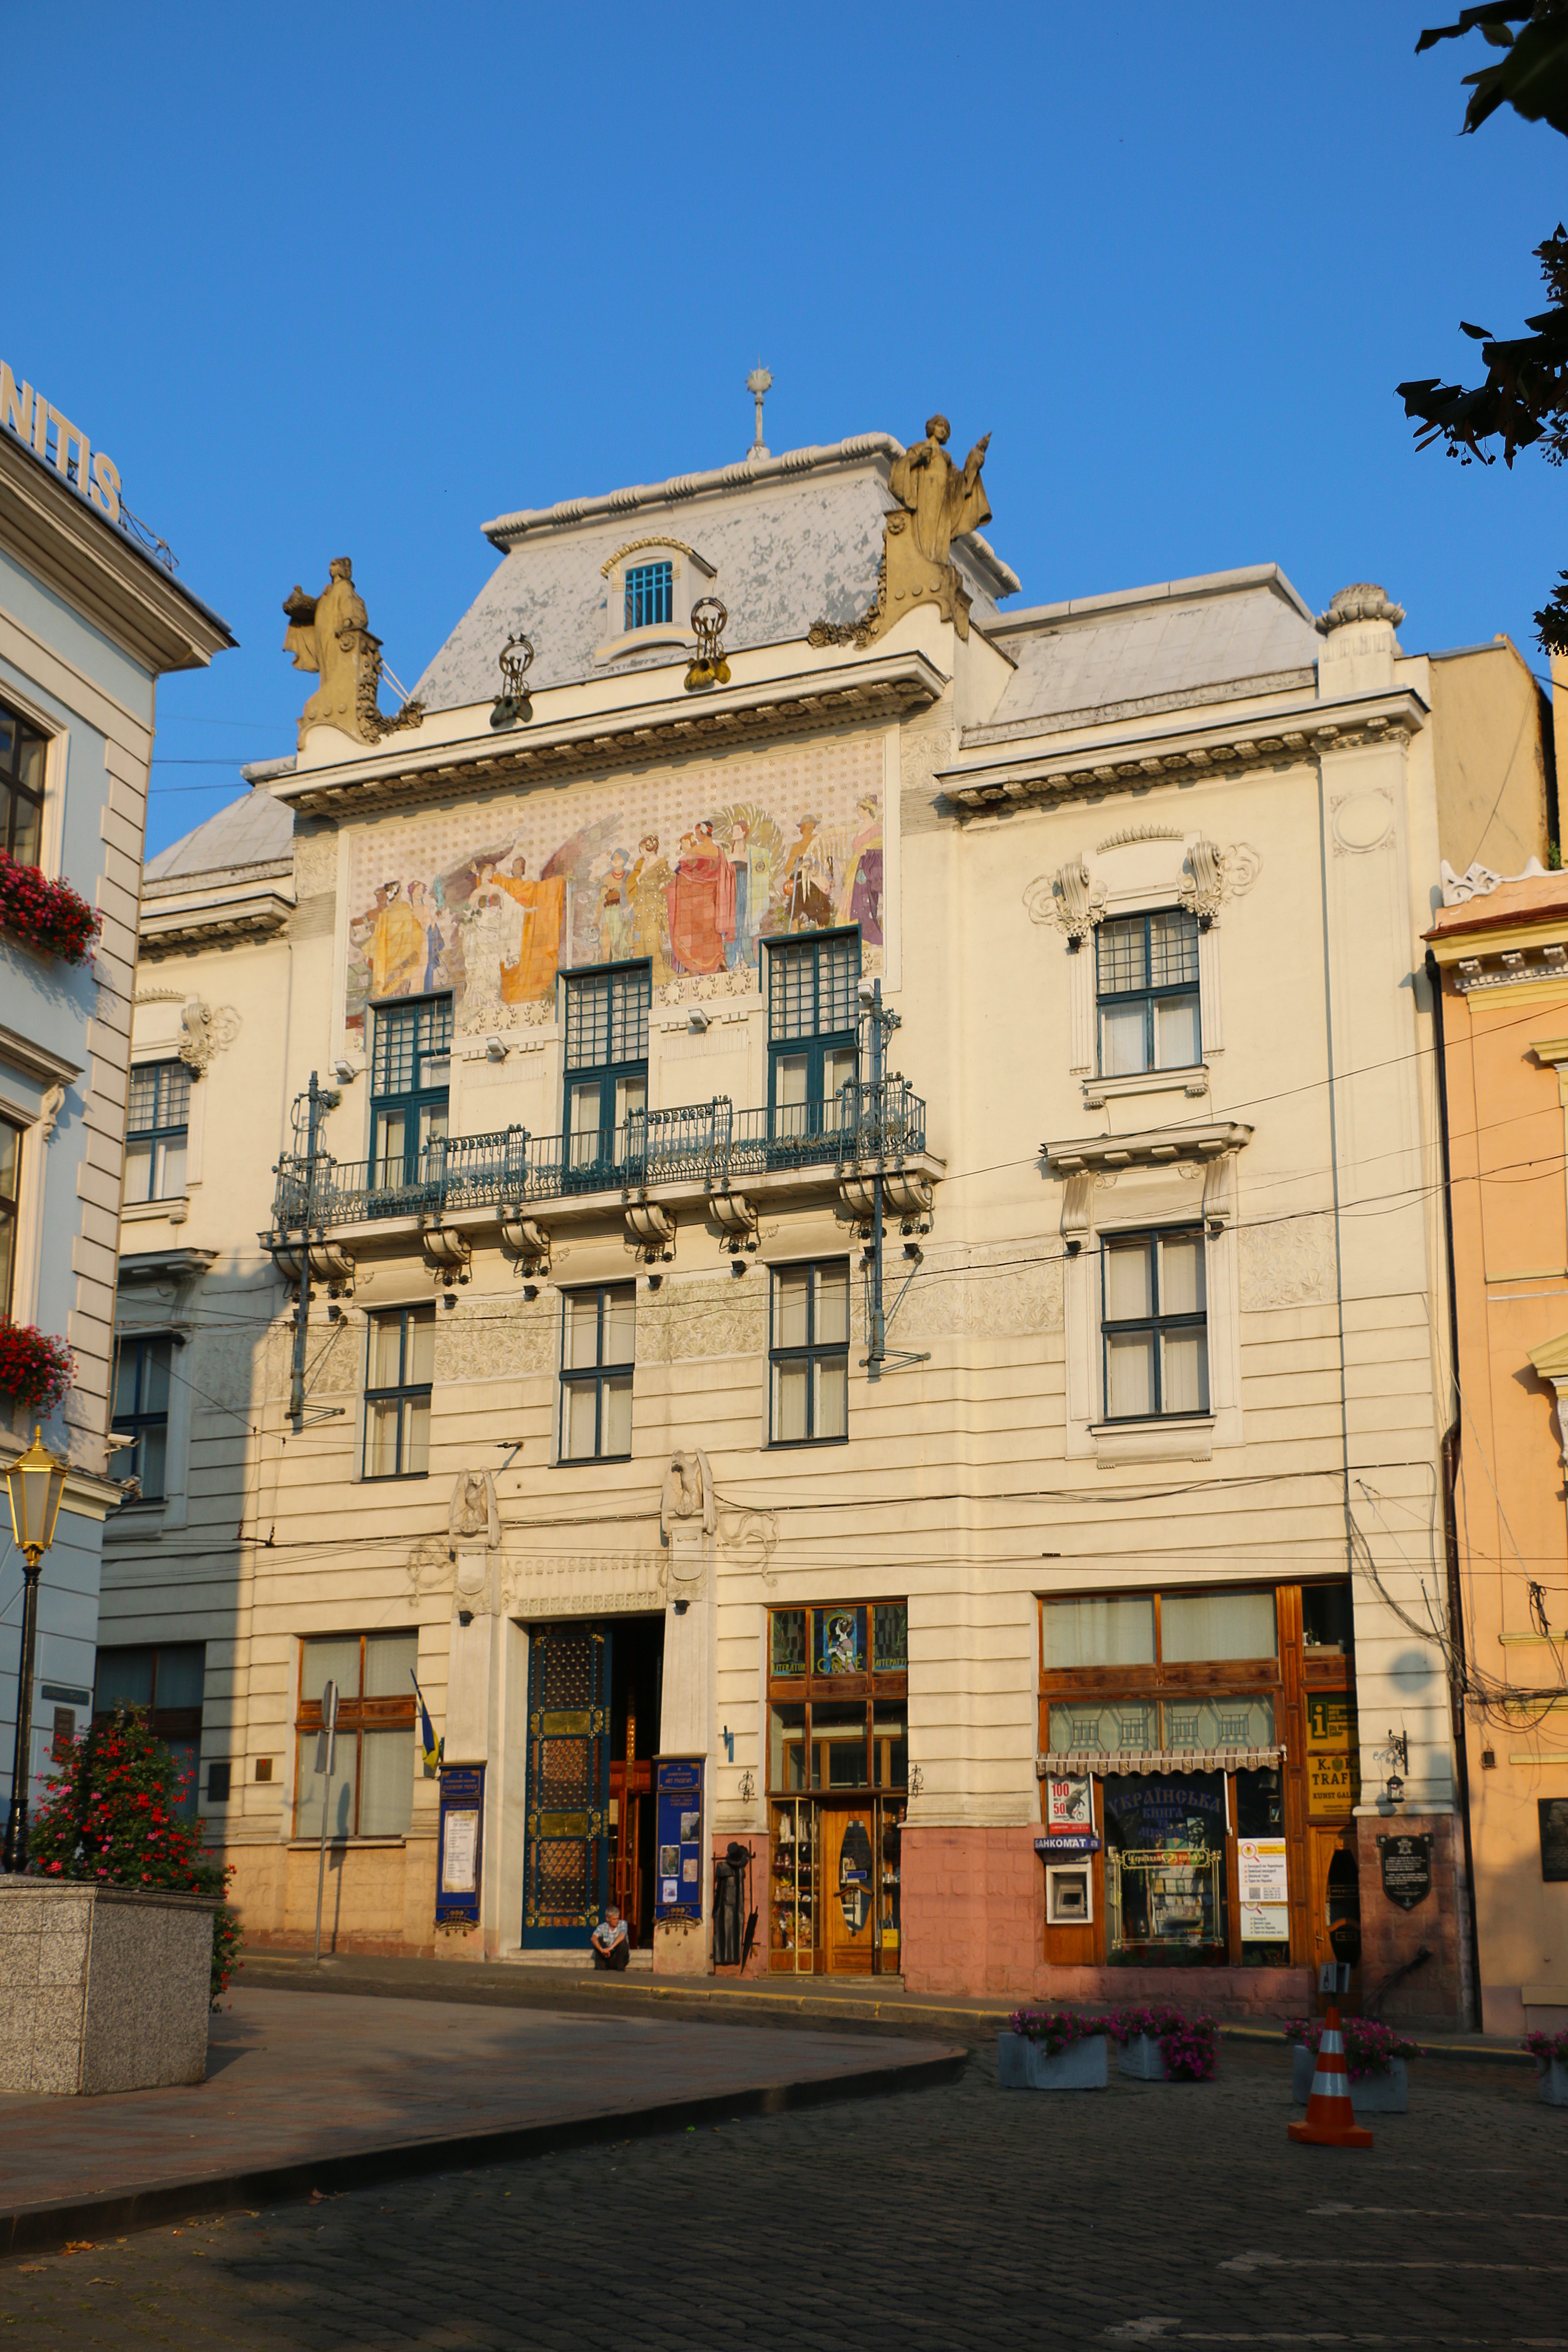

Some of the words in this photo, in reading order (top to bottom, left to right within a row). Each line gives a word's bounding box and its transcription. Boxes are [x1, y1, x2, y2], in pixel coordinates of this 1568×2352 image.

[1317, 1758, 1331, 1770] K.
[1052, 1783, 1069, 1797] 100
[1054, 1802, 1066, 1815] 50
[1107, 1787, 1222, 1818] УКРАЇНСЬКА
[1035, 1838, 1086, 1848] БАНКОМАТ
